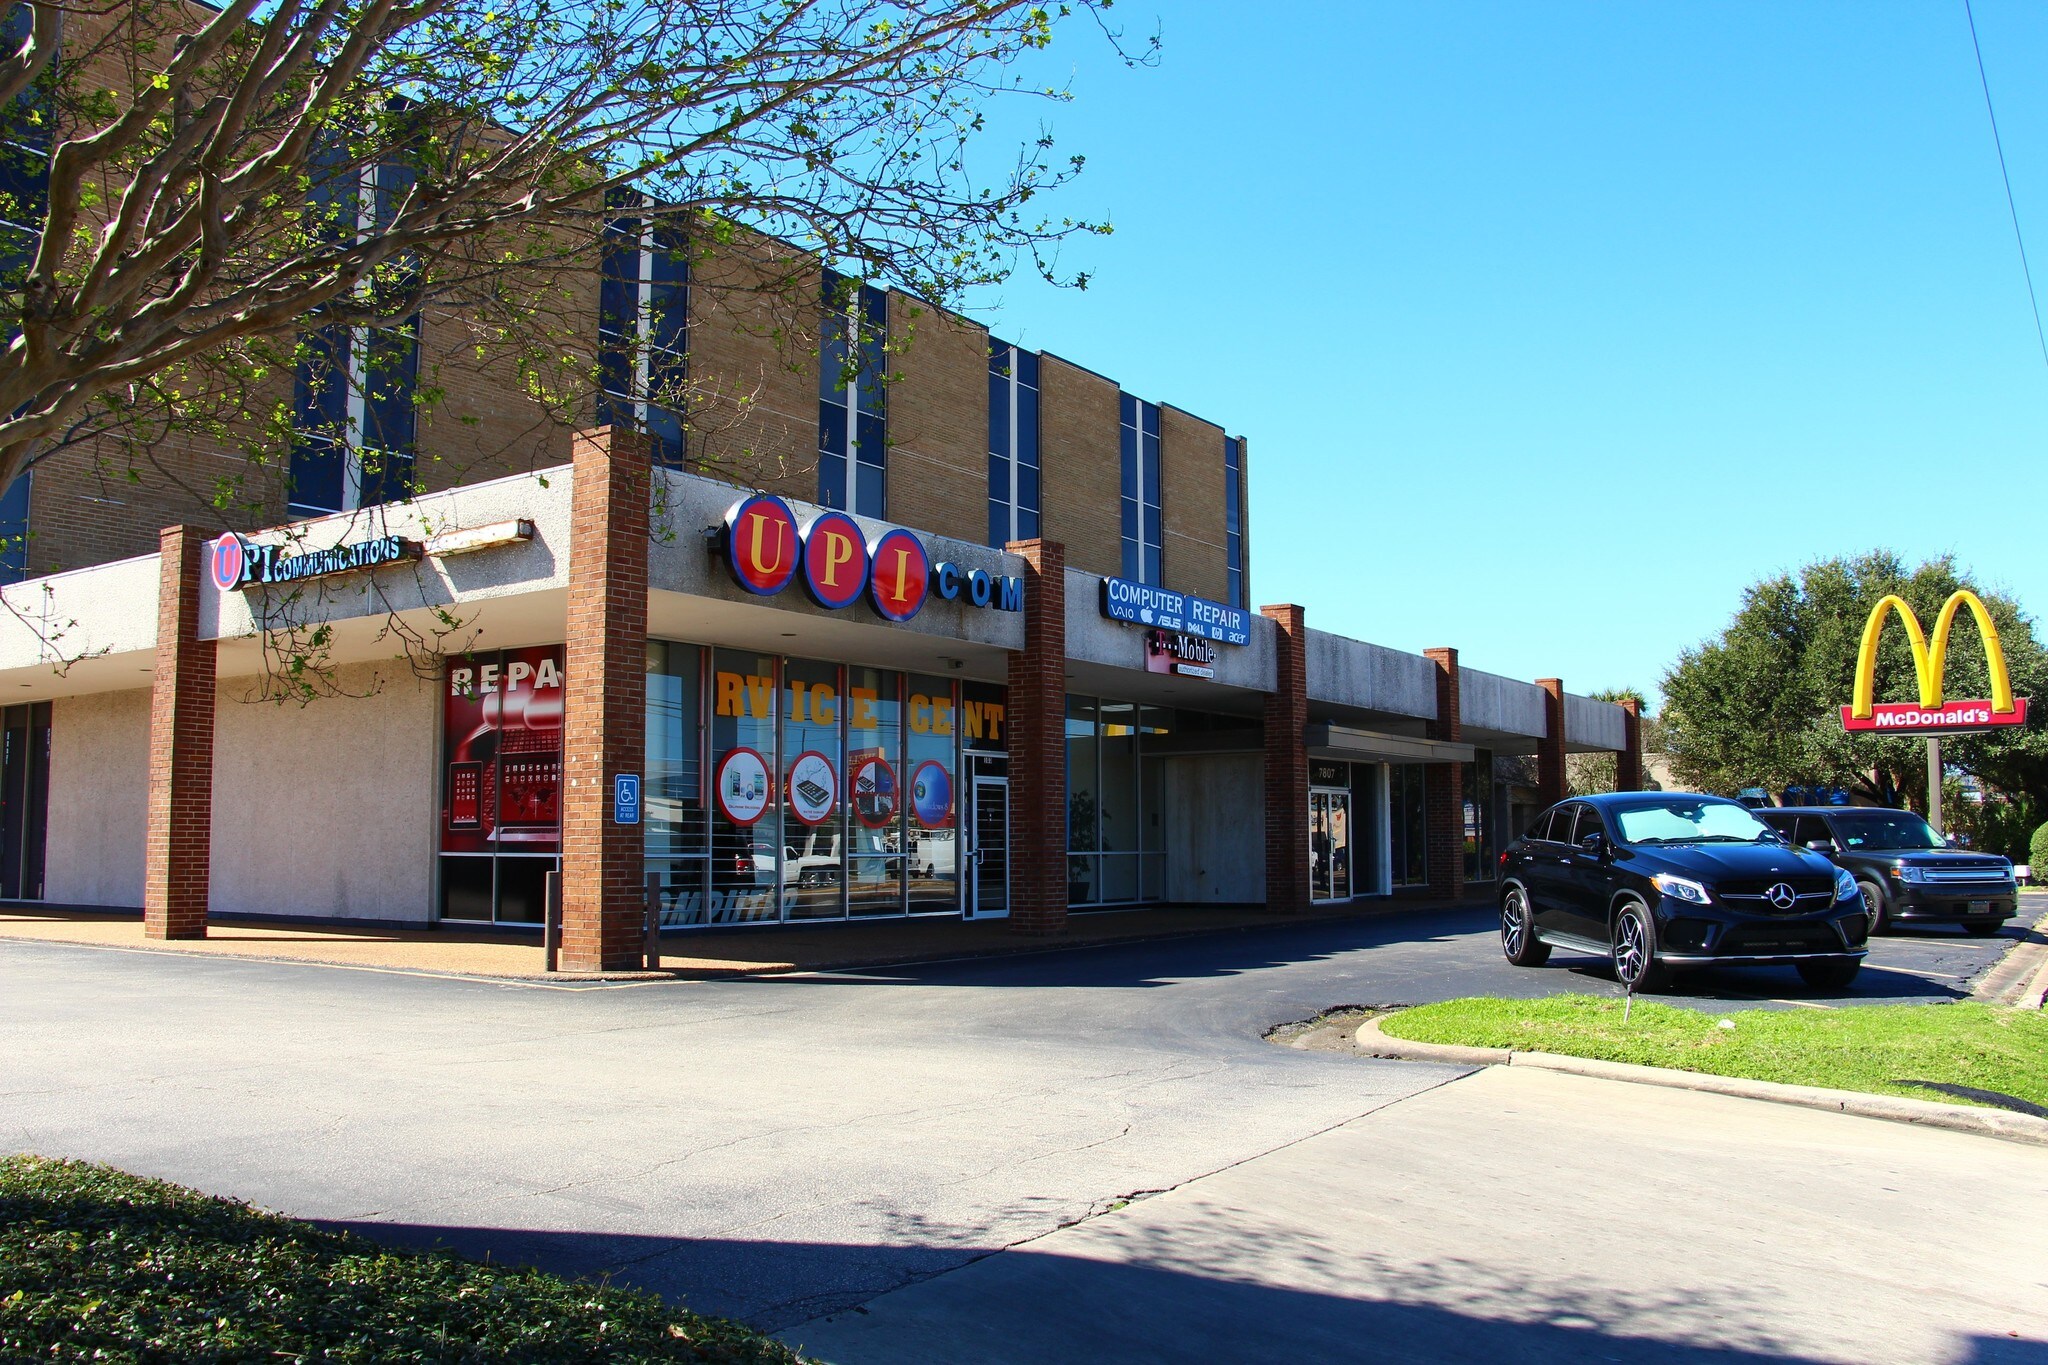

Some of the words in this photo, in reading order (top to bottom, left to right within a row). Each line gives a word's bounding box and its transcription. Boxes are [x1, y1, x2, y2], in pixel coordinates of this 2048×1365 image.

[274, 535, 400, 583] COMMUNICATIONS
[1109, 579, 1183, 614] COMPUTER
[1192, 600, 1241, 629] REPAIR
[1110, 604, 1134, 619] VAIO
[1157, 615, 1182, 629] ASUS
[1187, 621, 1205, 635] DELL
[1228, 631, 1246, 644] acer
[451, 658, 560, 696] REPA
[1875, 708, 1990, 727] McDonald's
[1319, 767, 1335, 778] 7807
